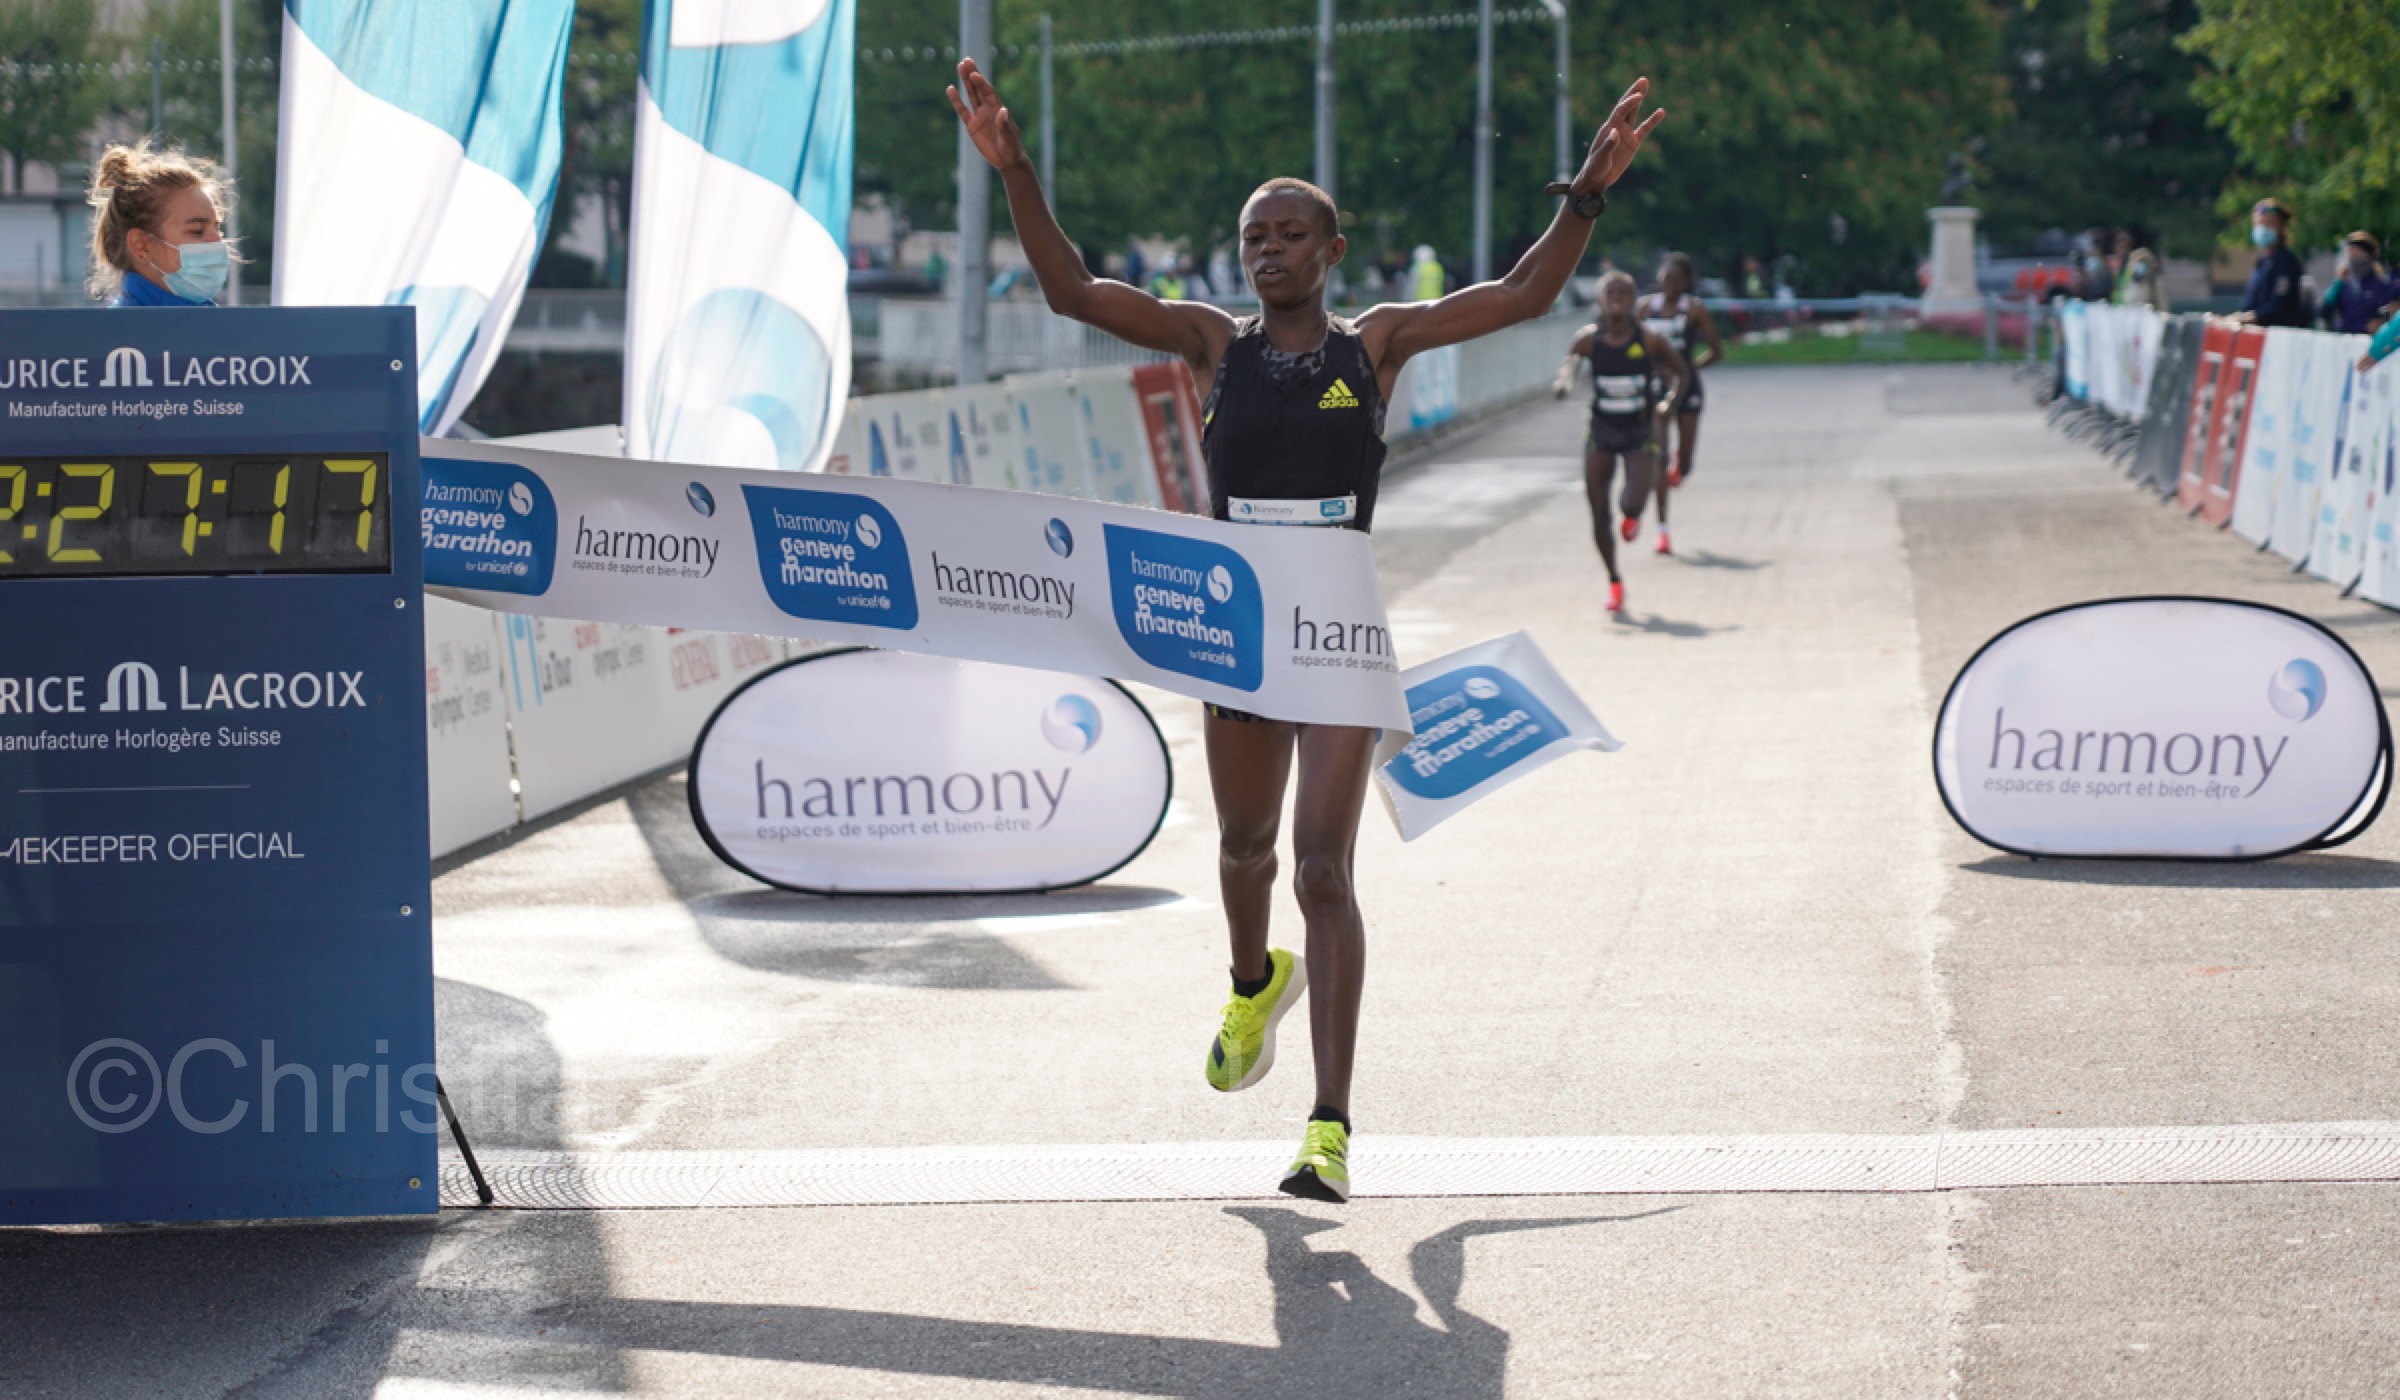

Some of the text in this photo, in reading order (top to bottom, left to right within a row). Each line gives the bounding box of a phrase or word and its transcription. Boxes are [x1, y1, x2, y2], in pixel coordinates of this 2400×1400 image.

[163, 351, 312, 386] LACROIX
[8, 398, 244, 420] Manufacture Horlogère Suisse
[425, 478, 503, 510] harmony
[772, 506, 850, 542] harmony
[575, 514, 720, 578] harmony
[478, 559, 514, 575] unicef
[572, 559, 604, 573] espaces
[608, 560, 618, 572] de
[620, 562, 644, 575] sport
[646, 563, 655, 575] et
[781, 558, 888, 590] marathon
[1130, 550, 1203, 594] harmony
[931, 550, 1074, 620] harmony
[1134, 610, 1234, 648] marathon
[1293, 605, 1391, 656] harm
[1292, 655, 1342, 668] espaces
[1345, 656, 1359, 668] de
[180, 665, 366, 711] LACROIX
[0, 725, 282, 752] anufacture Horlogère Suisse
[1988, 705, 2289, 798] harmony
[755, 758, 1071, 830] harmony
[1984, 777, 2240, 799] espaces de sport et bien-être
[756, 816, 1032, 842] espaces de sport et bien-être
[167, 832, 305, 861] OFFICIAL
